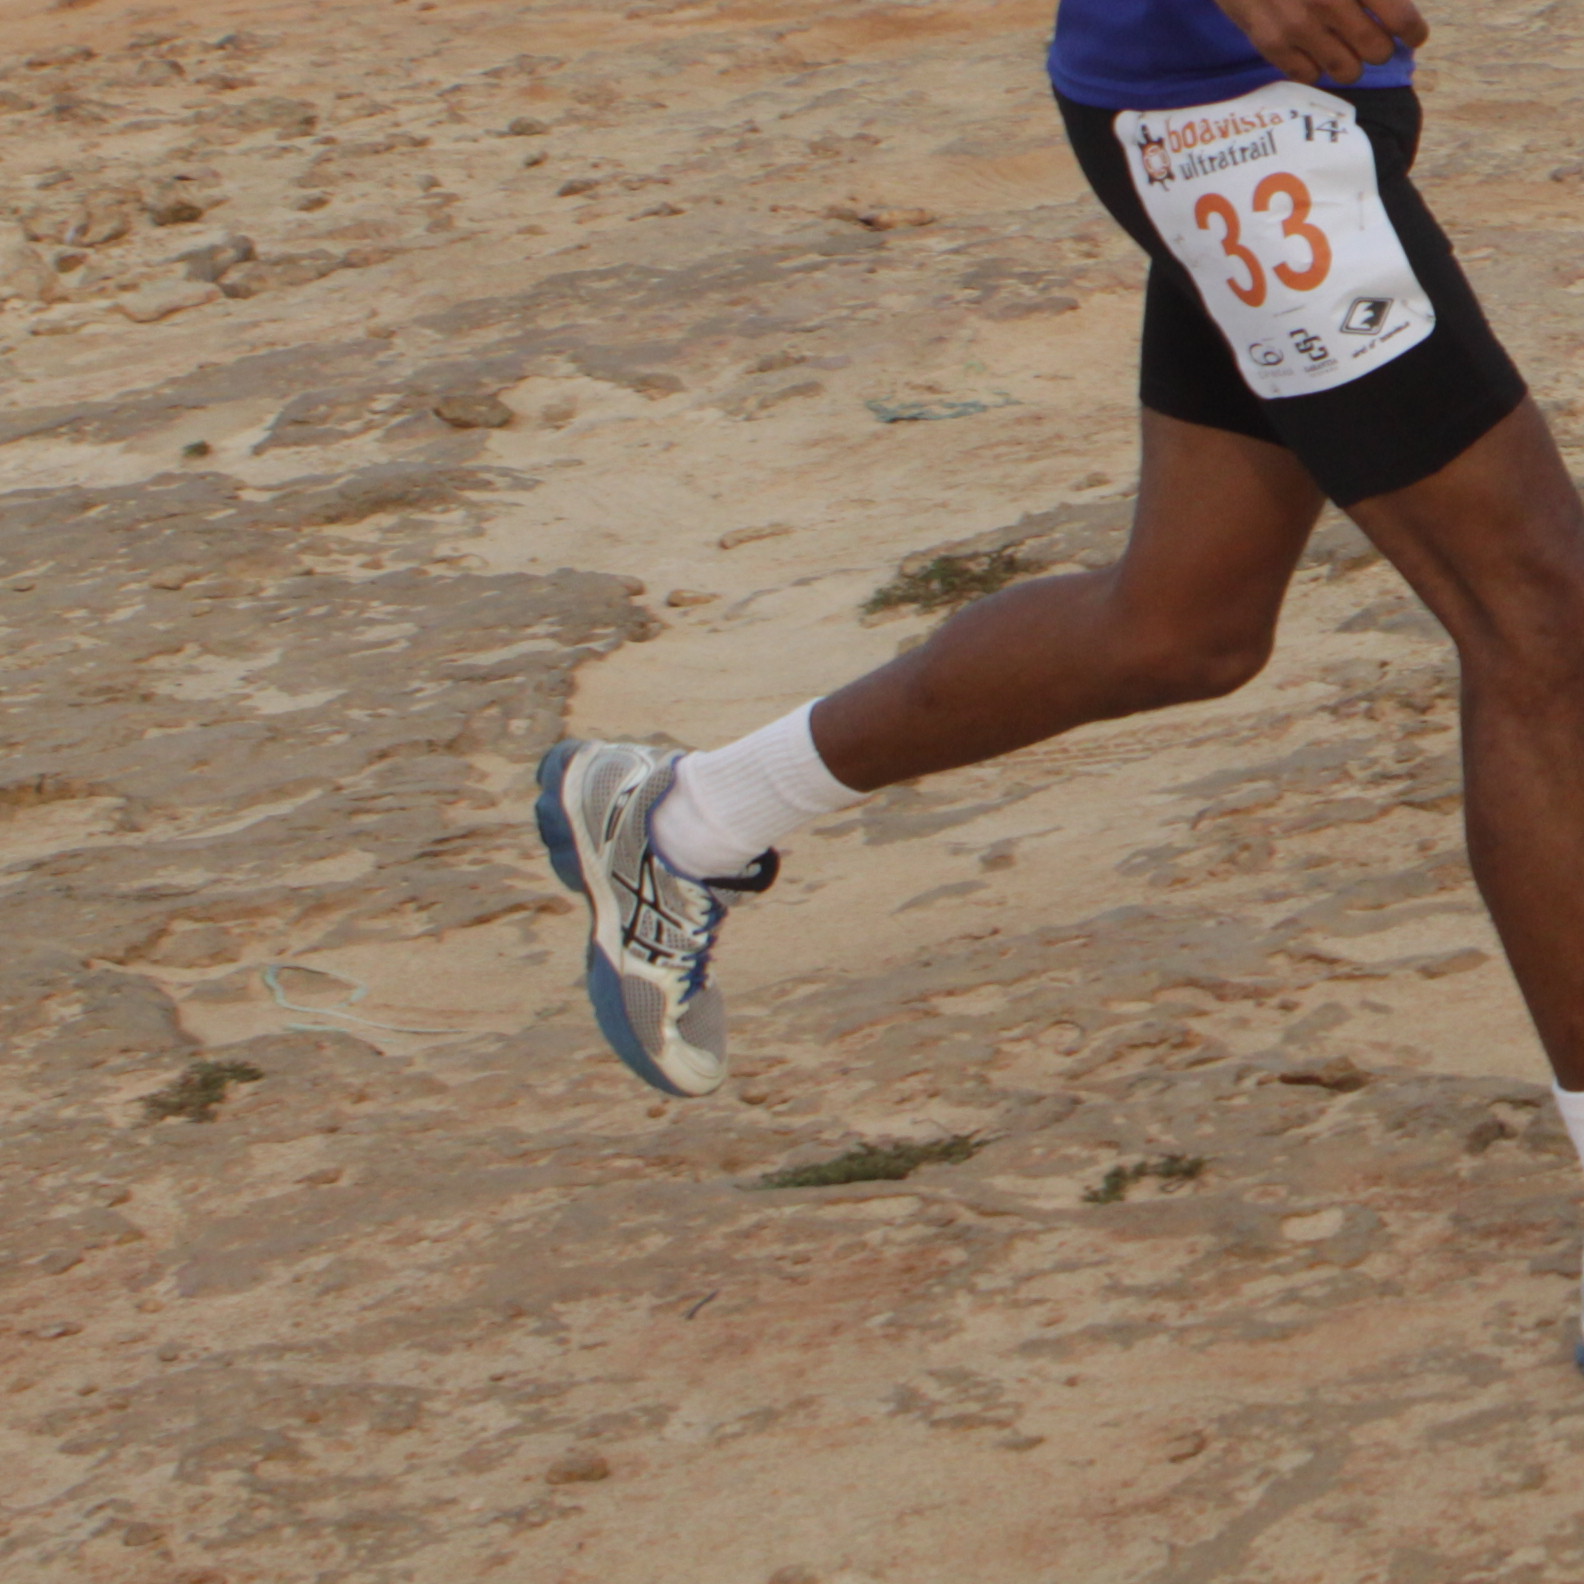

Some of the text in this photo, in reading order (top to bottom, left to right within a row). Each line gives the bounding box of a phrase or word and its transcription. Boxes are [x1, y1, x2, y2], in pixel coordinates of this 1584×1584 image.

[1165, 110, 1284, 154] boavista
[1180, 128, 1278, 180] ultratrail
[1193, 171, 1333, 309] 33
